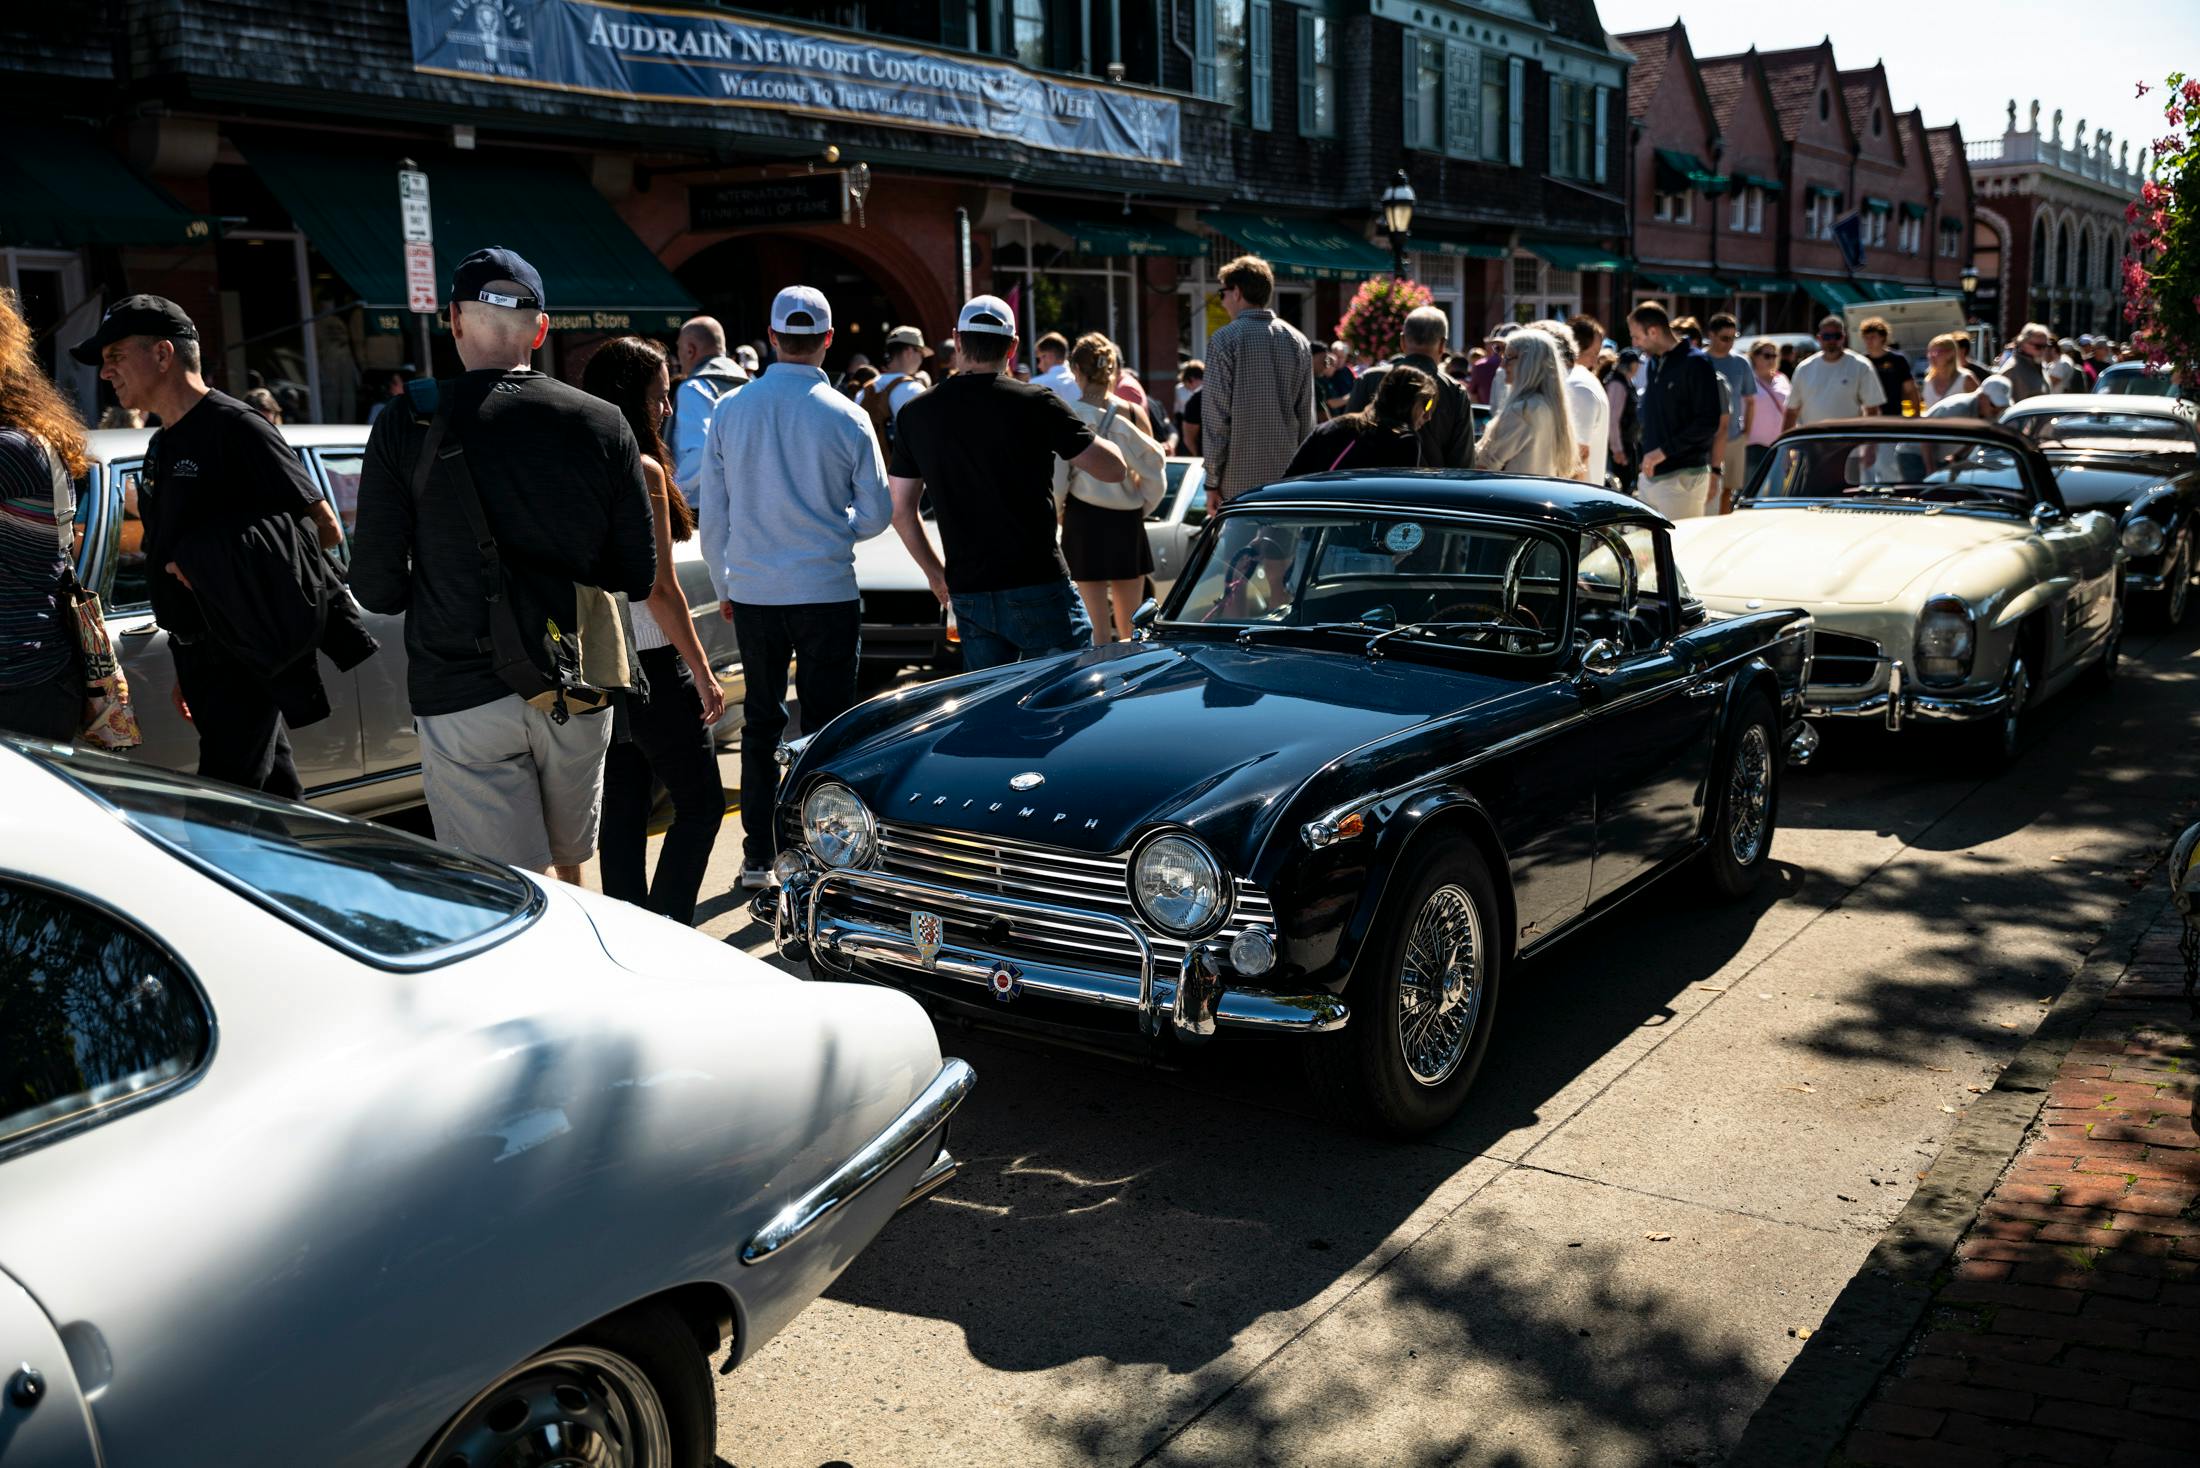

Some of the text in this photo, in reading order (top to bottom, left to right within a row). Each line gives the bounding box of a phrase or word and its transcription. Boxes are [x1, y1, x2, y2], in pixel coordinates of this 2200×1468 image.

[451, 0, 525, 30] AUAIN
[589, 11, 733, 59] AUDRAIN
[738, 29, 864, 75] NEWPORT
[1045, 86, 1097, 121] WEEK
[720, 73, 810, 101] WELCOME
[549, 312, 630, 329] useum Store
[909, 791, 1099, 830] TRIUMPH
